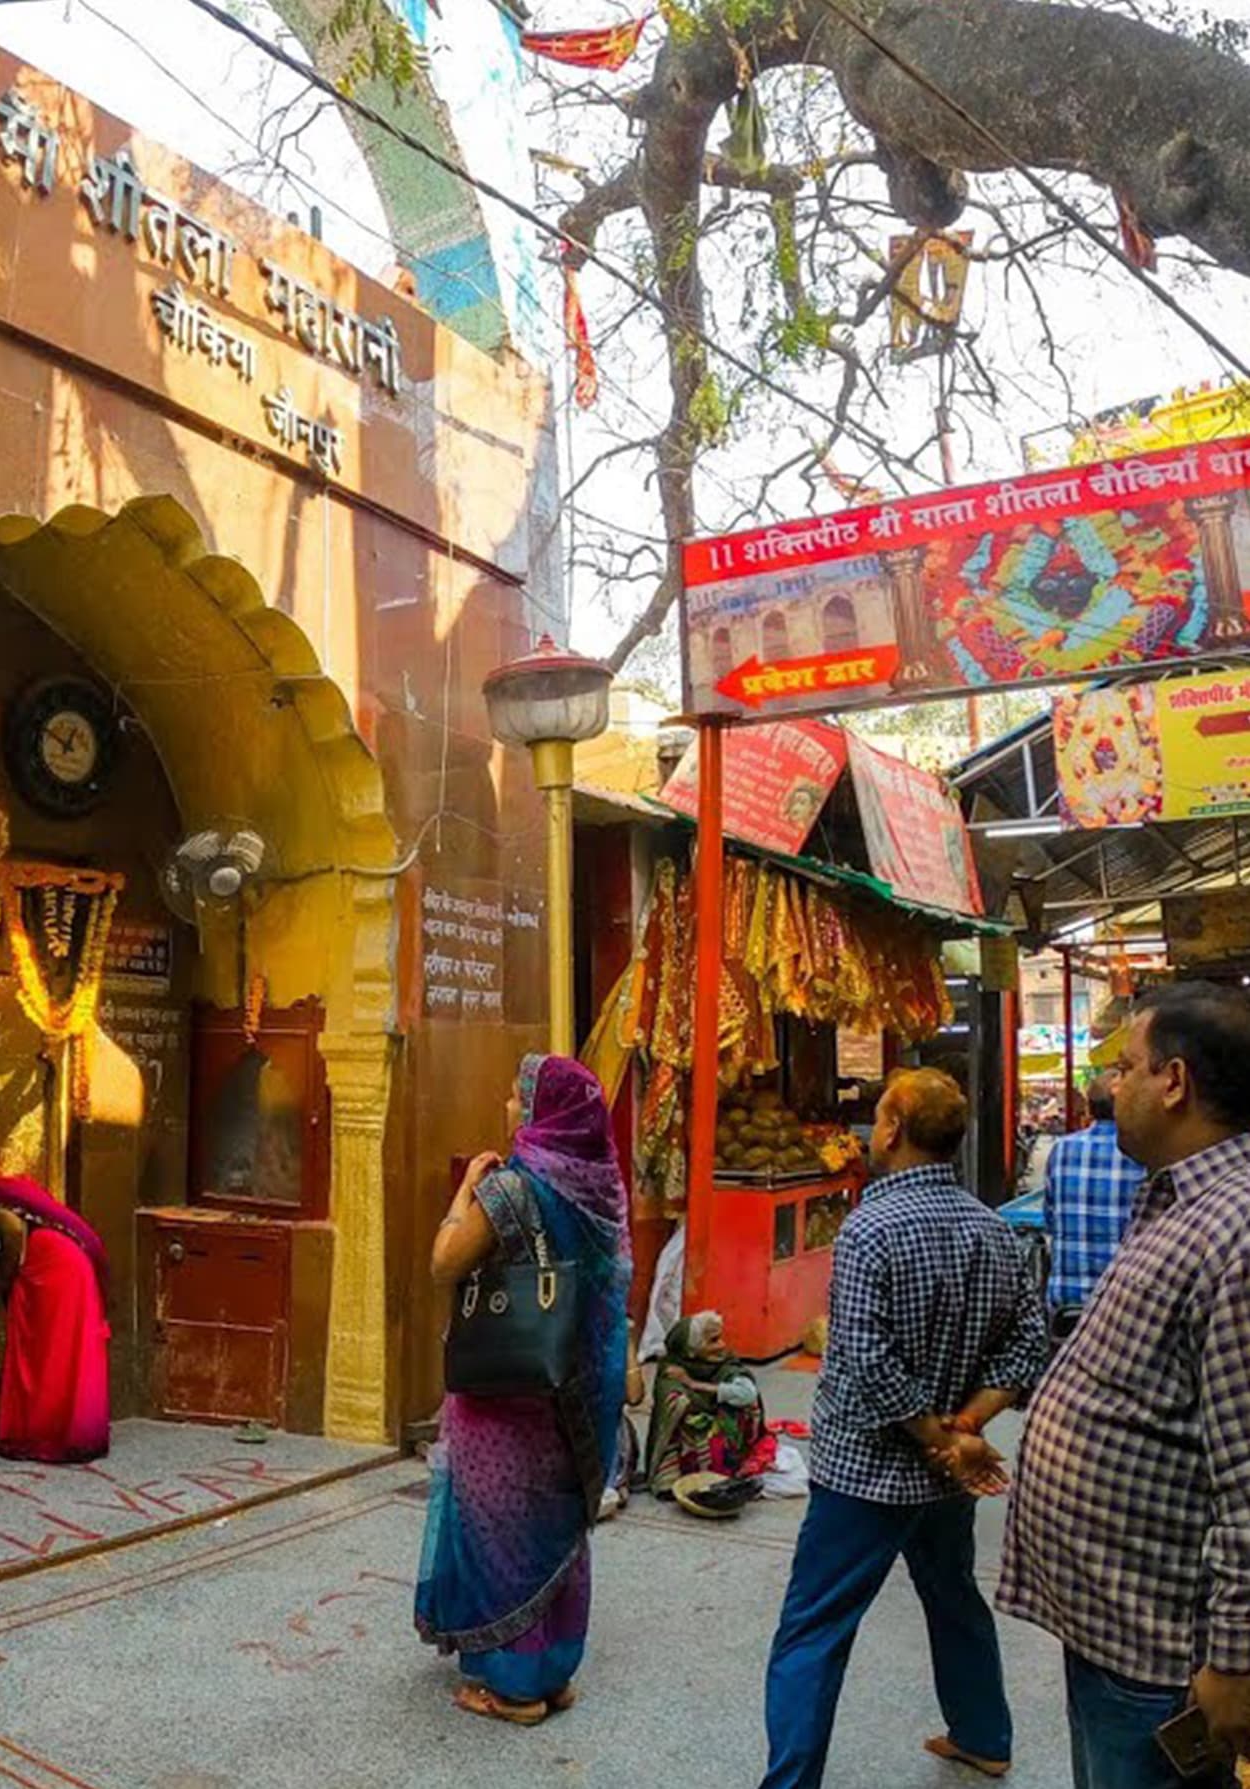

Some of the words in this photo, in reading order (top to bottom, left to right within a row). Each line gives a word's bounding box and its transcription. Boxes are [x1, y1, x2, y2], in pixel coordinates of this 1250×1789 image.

[79, 150, 235, 299] शीतला
[258, 257, 402, 399] महारानी
[261, 386, 345, 478] जौनपुर
[743, 517, 860, 563] शक्तिपीठ
[868, 505, 902, 538] श्री
[912, 496, 976, 530] माता
[985, 478, 1081, 518] शीतला
[1090, 451, 1200, 498] चौकियाँ
[742, 666, 816, 696] प्रवेश
